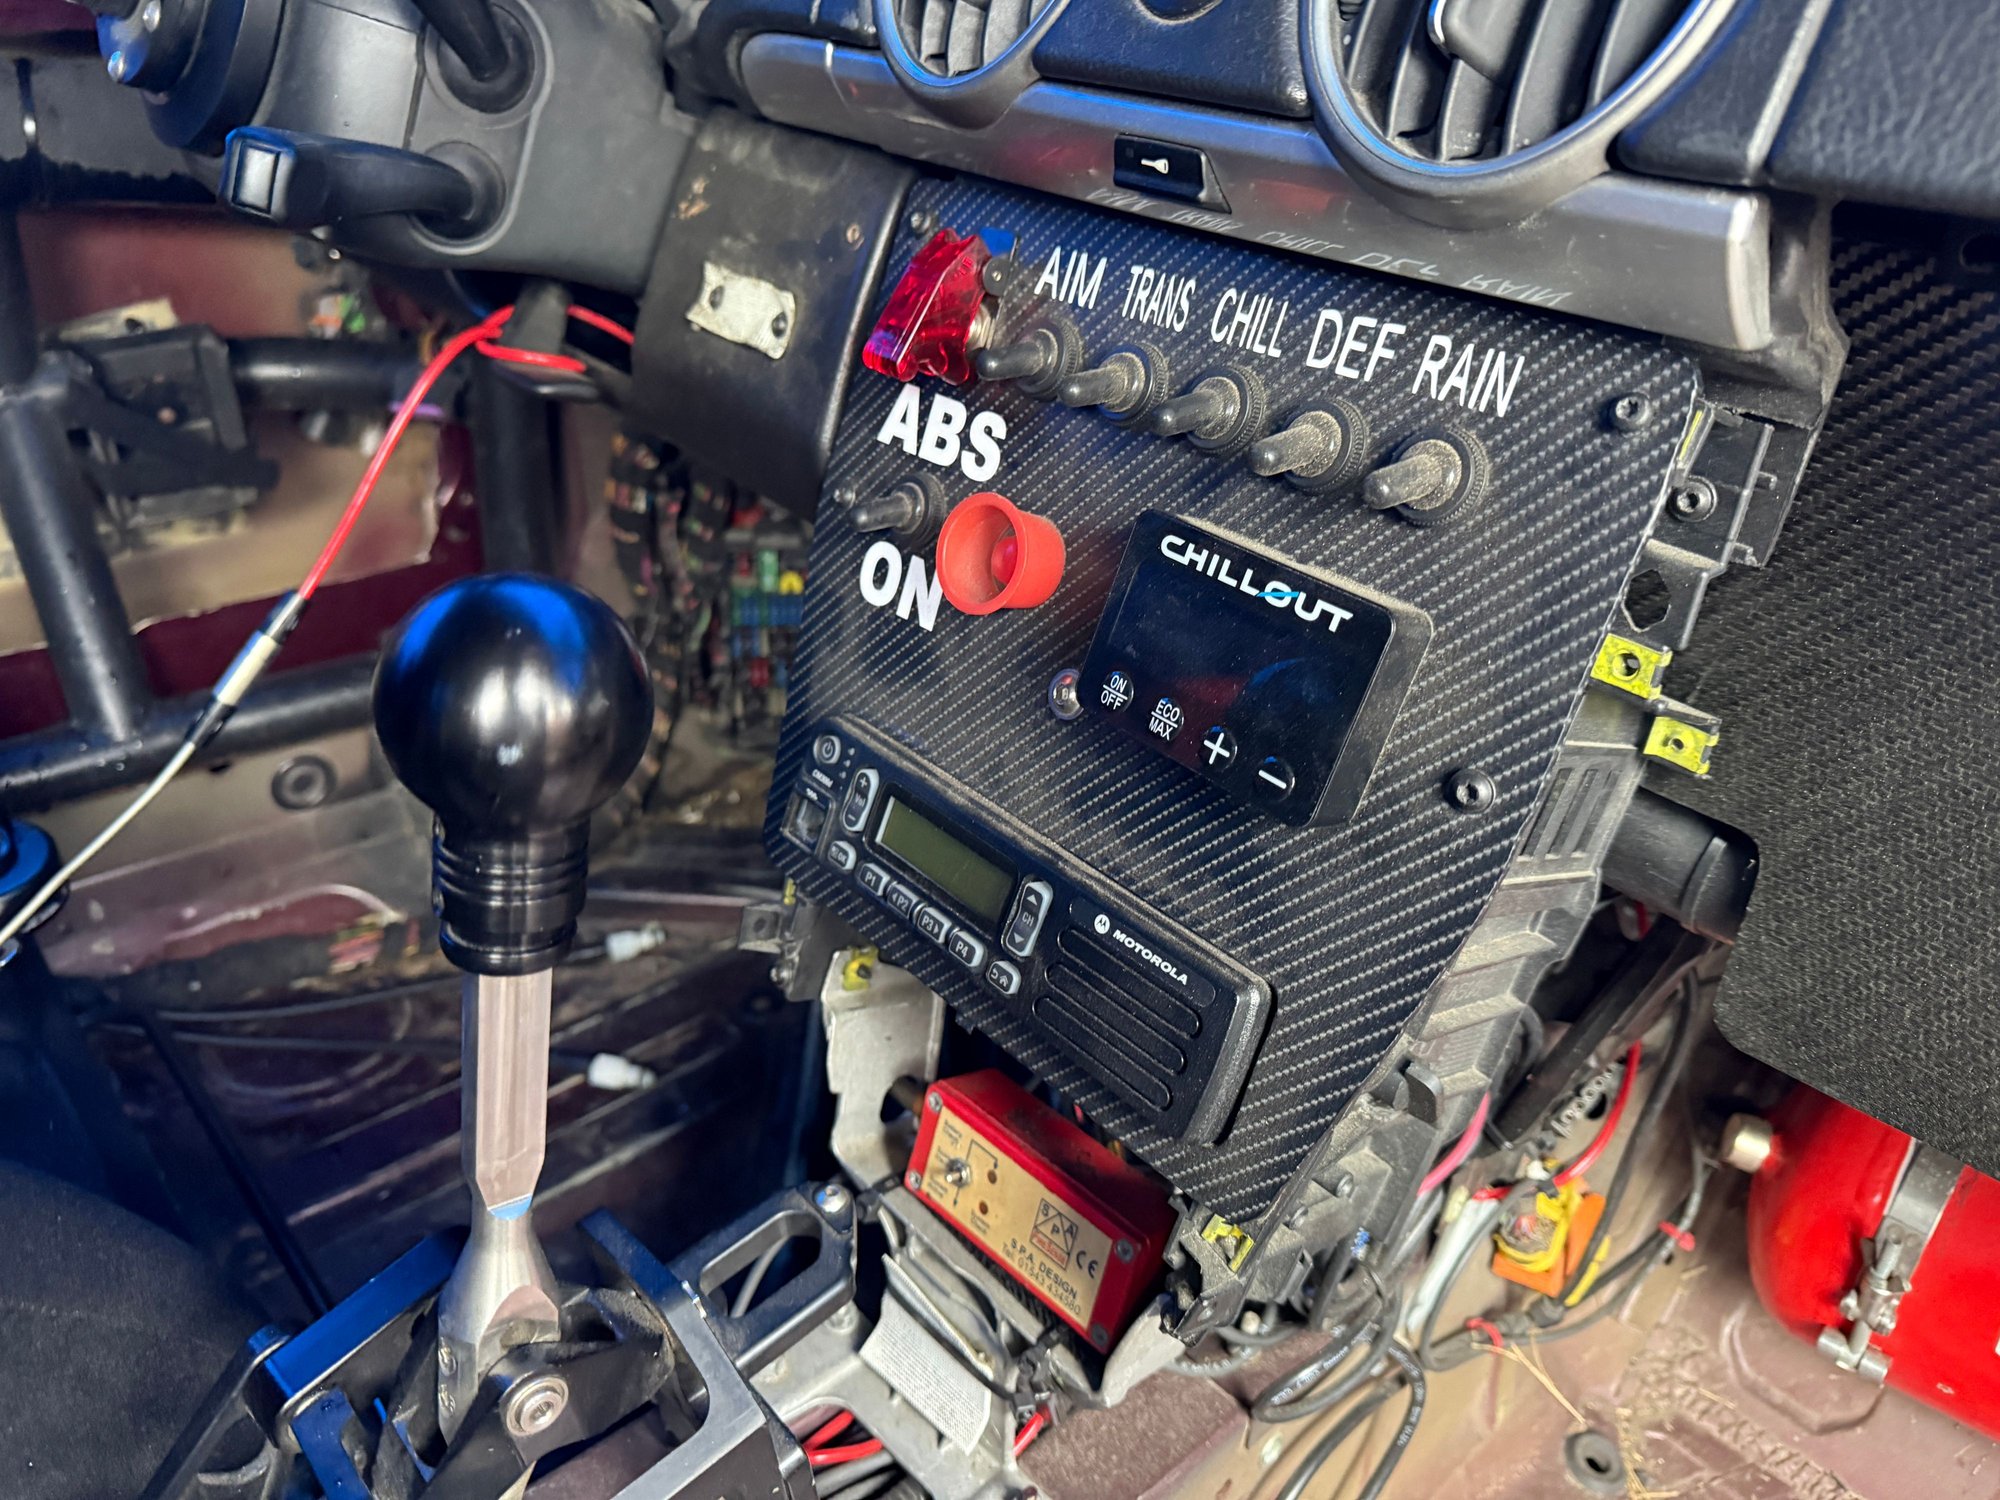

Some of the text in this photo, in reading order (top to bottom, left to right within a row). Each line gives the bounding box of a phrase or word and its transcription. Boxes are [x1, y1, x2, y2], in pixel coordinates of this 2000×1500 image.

[1034, 246, 1526, 418] AIM TRANS CHILL DEF RAIN
[876, 383, 1007, 483] ABS
[859, 541, 943, 632] ON
[1160, 534, 1354, 633] CHILLOUT
[1110, 674, 1128, 693] ON
[1100, 690, 1124, 710] OFF
[1155, 698, 1180, 722] ECO
[1148, 716, 1173, 741] MAX
[864, 872, 876, 887] P1
[896, 896, 909, 911] P2
[921, 915, 933, 931] P3
[1022, 911, 1035, 927] CH
[955, 940, 968, 958] P4
[1112, 929, 1188, 986] MOTOROLA
[1039, 1262, 1077, 1300] DESIGN
